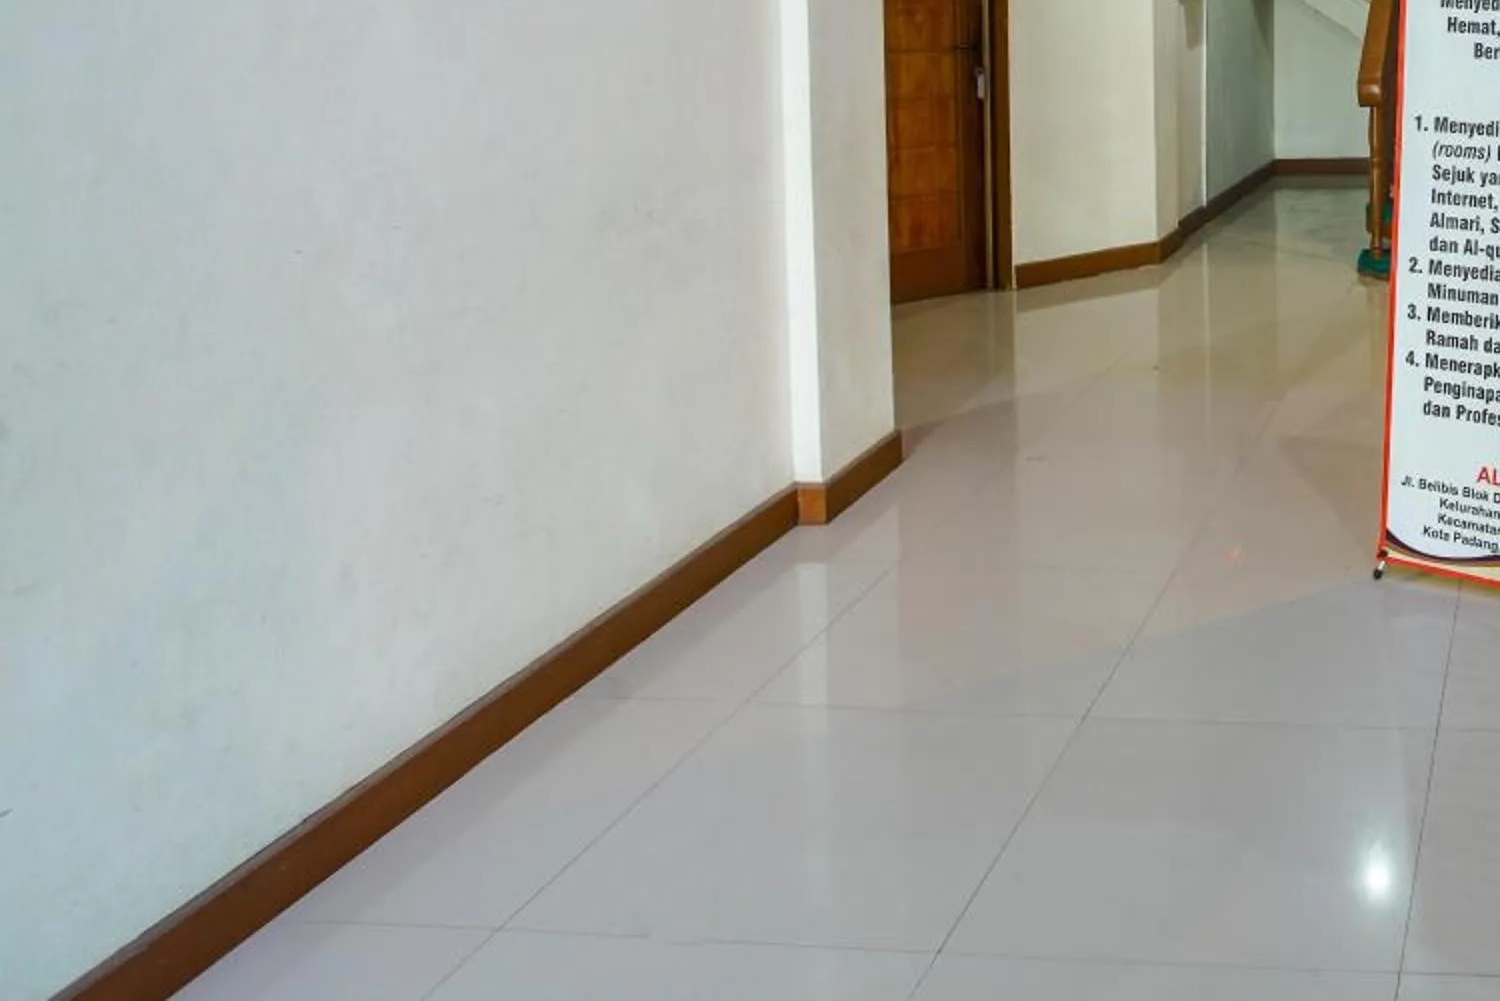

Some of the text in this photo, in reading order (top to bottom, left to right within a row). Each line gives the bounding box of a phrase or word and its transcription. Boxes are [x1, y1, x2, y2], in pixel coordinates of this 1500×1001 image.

[1447, 17, 1500, 37] Hemat,
[1414, 116, 1428, 131] 1.
[1432, 140, 1491, 163] (rooms)
[1432, 164, 1475, 184] Sejuk
[1431, 188, 1499, 212] Internet,
[1429, 212, 1485, 234] Almari,
[1429, 236, 1459, 254] dan
[1409, 257, 1423, 274] 2.
[1427, 283, 1499, 306] Minuman
[1407, 304, 1421, 320] 3.
[1426, 329, 1479, 352] Ramah
[1405, 350, 1420, 367] 4.
[1423, 401, 1451, 419] dan
[1418, 479, 1459, 496] Belibis
[1462, 486, 1489, 501] Blok
[1439, 498, 1500, 519] Kelurahan
[1423, 524, 1451, 540] Kota
